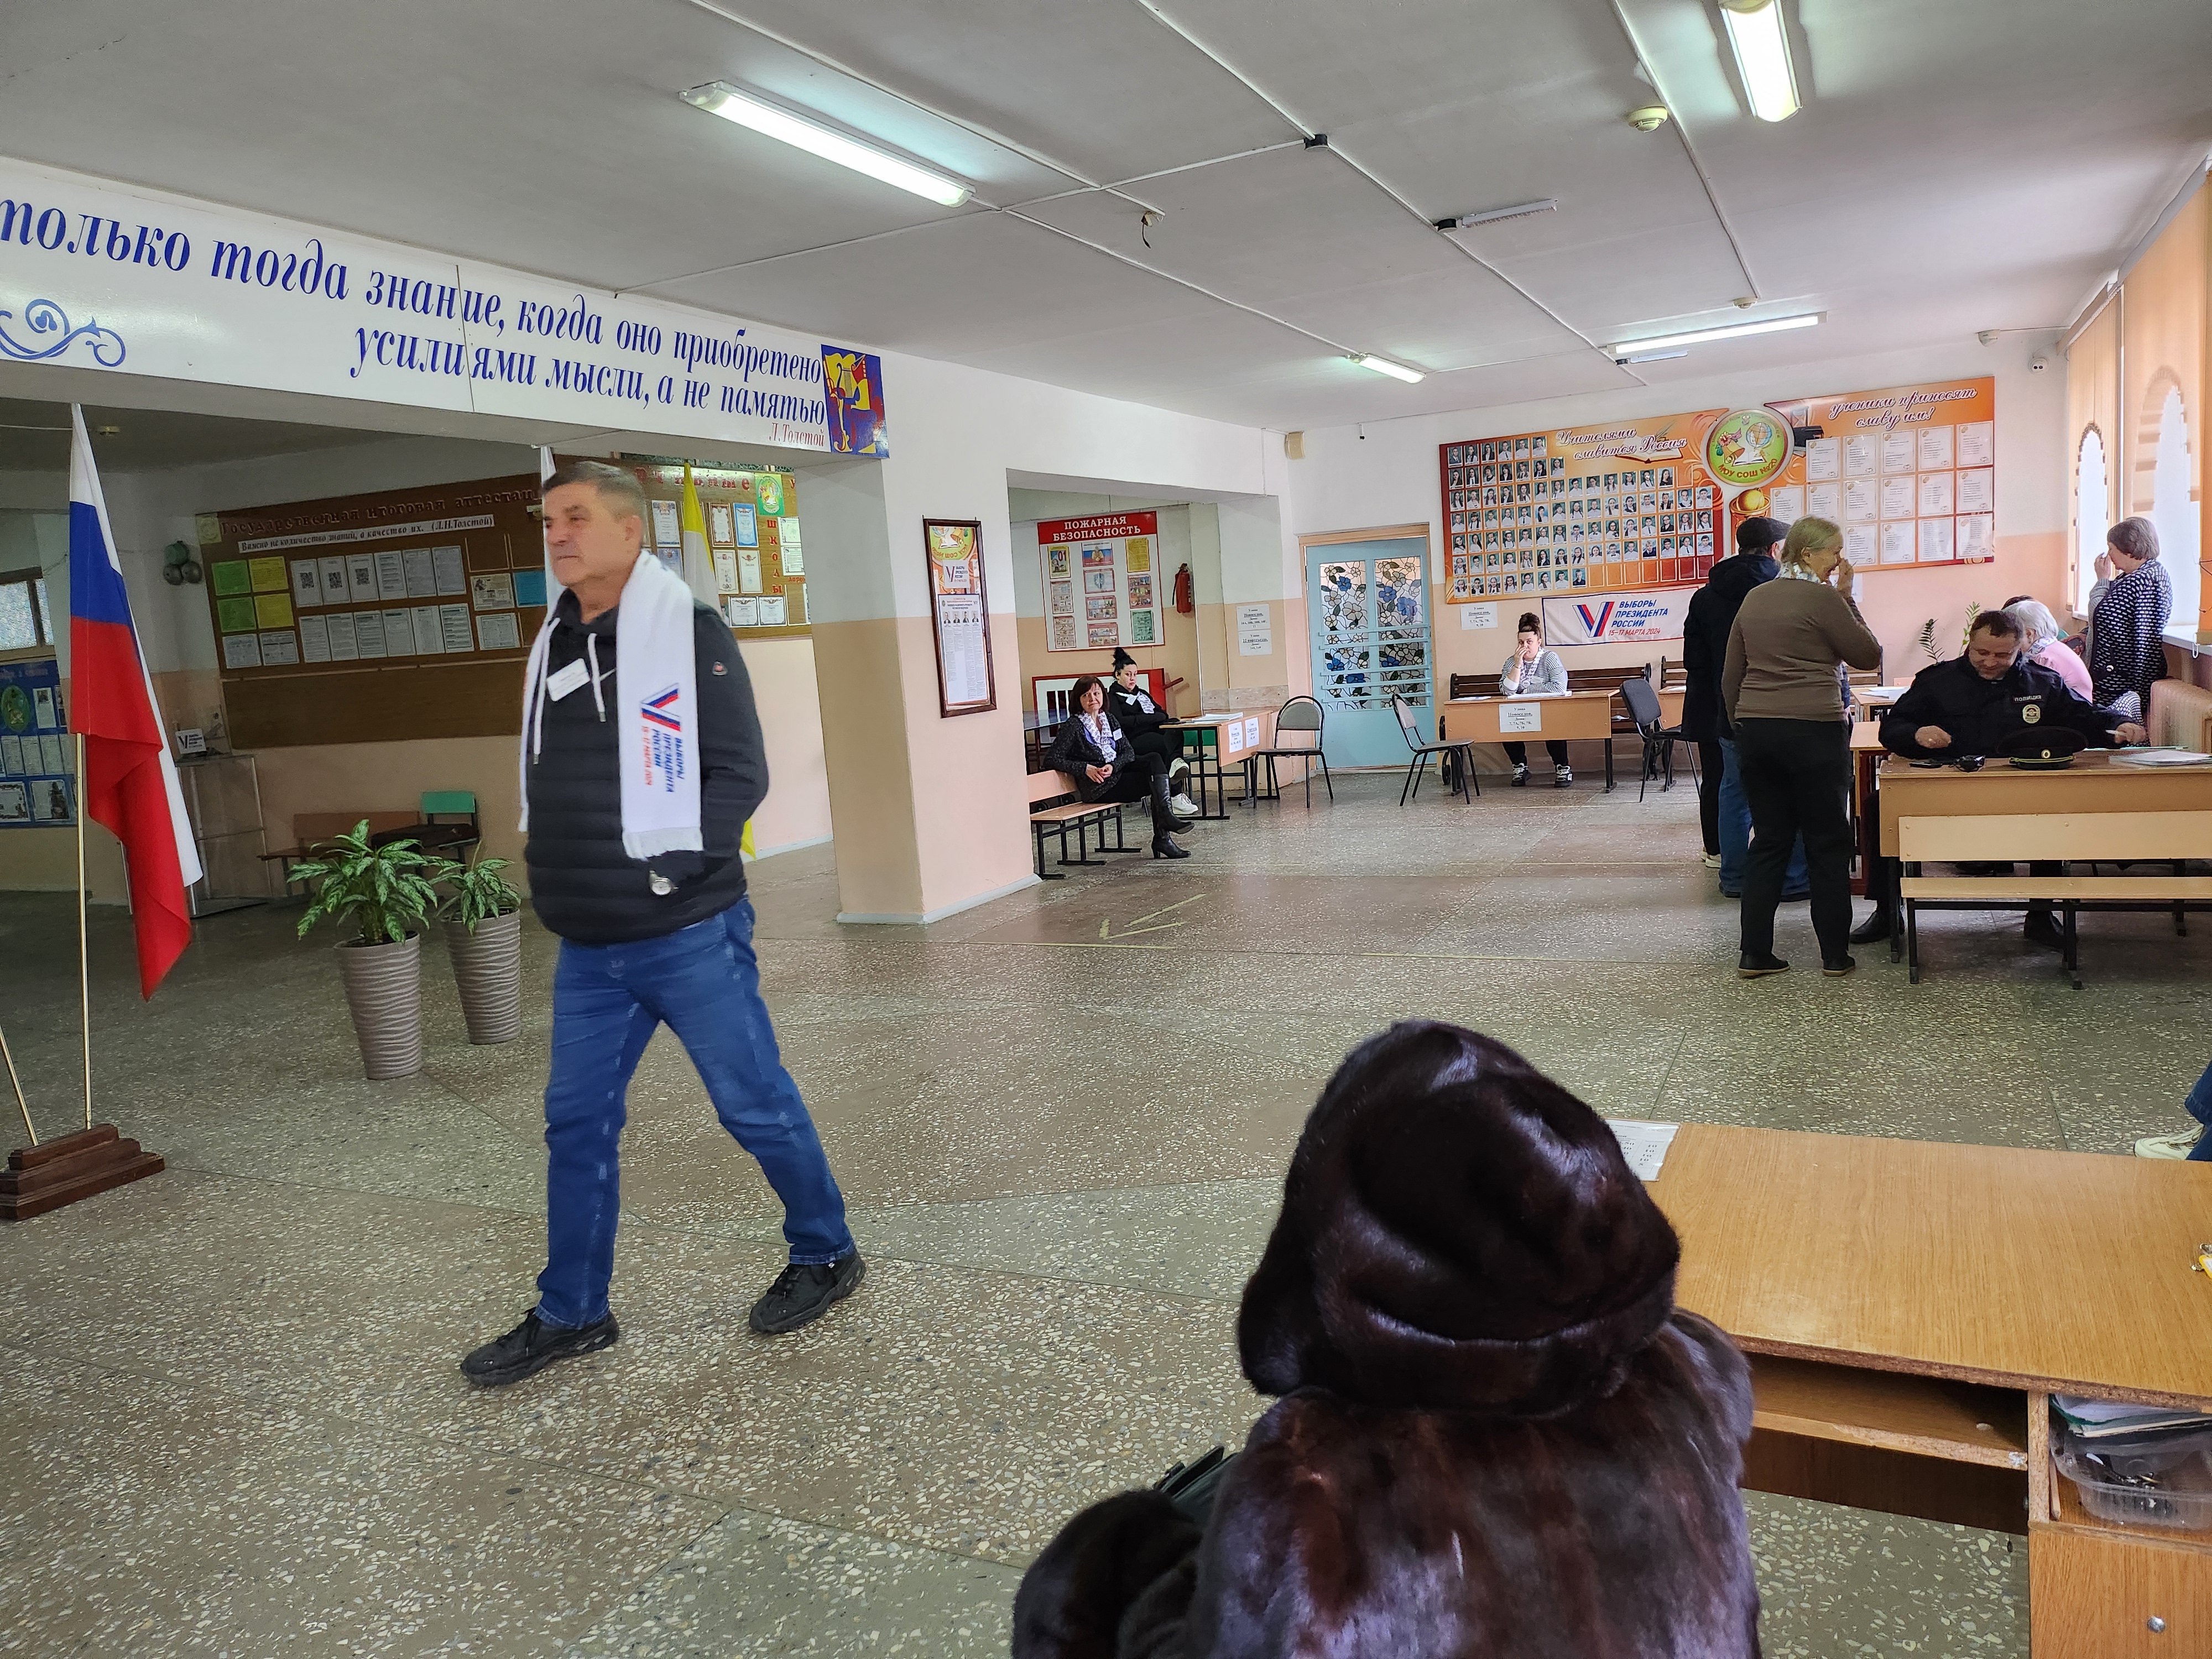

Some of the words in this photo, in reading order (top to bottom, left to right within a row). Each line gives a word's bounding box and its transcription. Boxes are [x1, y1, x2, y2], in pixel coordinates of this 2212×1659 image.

[0, 200, 191, 271] только
[210, 238, 349, 300] тогда
[366, 269, 504, 338] знание,
[518, 294, 603, 345] когда
[617, 320, 661, 355] оно
[674, 327, 822, 384] приобретено
[351, 327, 536, 385] усилиями
[545, 358, 651, 410] мысли,
[658, 379, 674, 405] а
[684, 379, 711, 409] не
[721, 385, 825, 425] памятью
[1829, 398, 1895, 419] ученики
[1899, 388, 1977, 411] приносят
[1855, 409, 1901, 430] славу
[1903, 406, 1935, 422] им!
[1556, 429, 1636, 446] Учителями
[1574, 444, 1636, 460] славится
[1640, 435, 1687, 452] Россия
[1718, 463, 1735, 477] МОУ
[1053, 526, 1141, 541] БЕЗОПАСНОСТЬ
[1065, 516, 1126, 530] ПОЖАРНАЯ
[1615, 608, 1668, 618] ПРЕЗИДЕНТА
[1619, 599, 1657, 608] ВЫБОРЫ
[651, 729, 663, 768] РОССИИ
[675, 738, 685, 779] ВЫБОРЫ
[662, 733, 675, 792] ПРЕЗИДЕНТА
